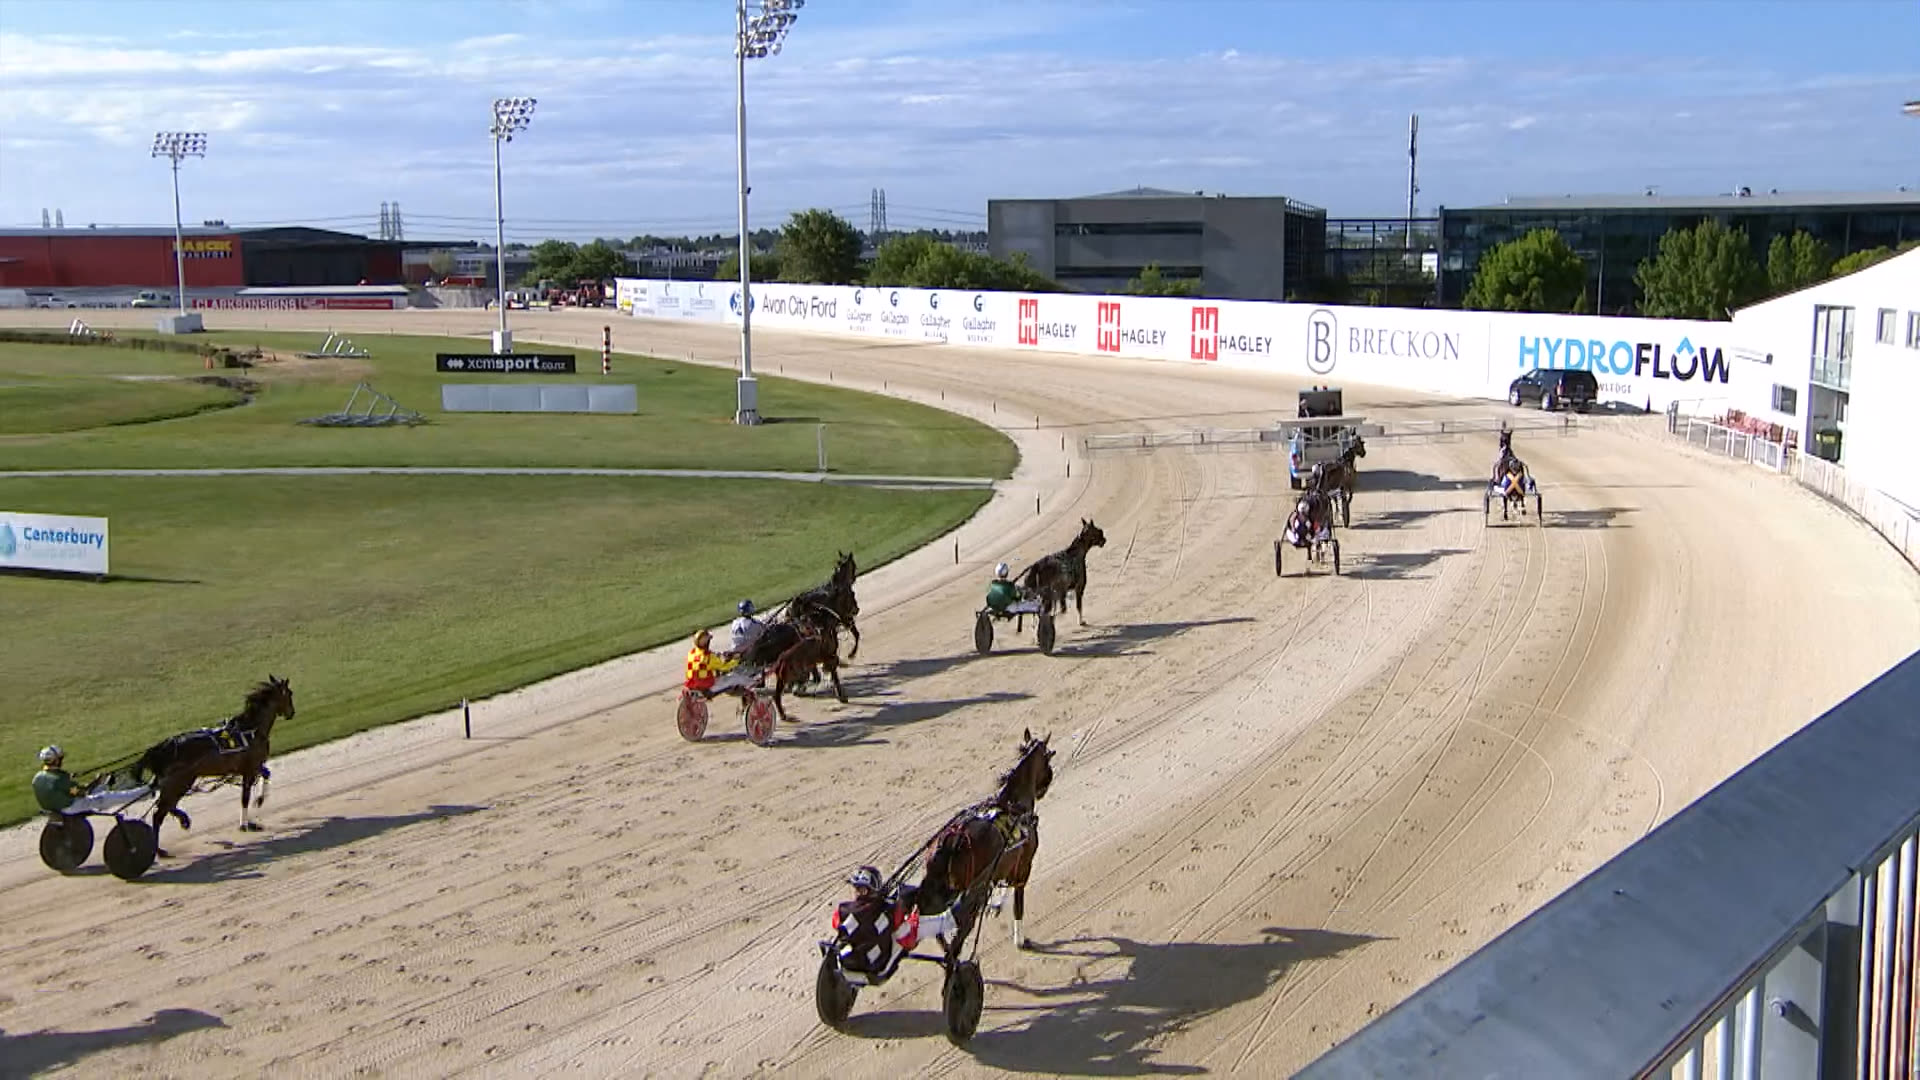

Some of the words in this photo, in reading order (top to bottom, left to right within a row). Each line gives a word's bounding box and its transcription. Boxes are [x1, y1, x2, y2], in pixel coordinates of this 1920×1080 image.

[762, 294, 787, 314] Avon
[788, 295, 809, 320] City
[811, 296, 837, 318] Ford
[1038, 323, 1077, 338] HAGLEY
[1121, 330, 1166, 346] HAGLEY
[1313, 321, 1331, 363] B
[1219, 336, 1272, 354] HAGLEY
[1349, 327, 1460, 360] BRECKON
[467, 356, 567, 371] xcmsport.co.nz
[1519, 336, 1731, 384] HYDROFLOW
[23, 526, 104, 549] Canterbury
